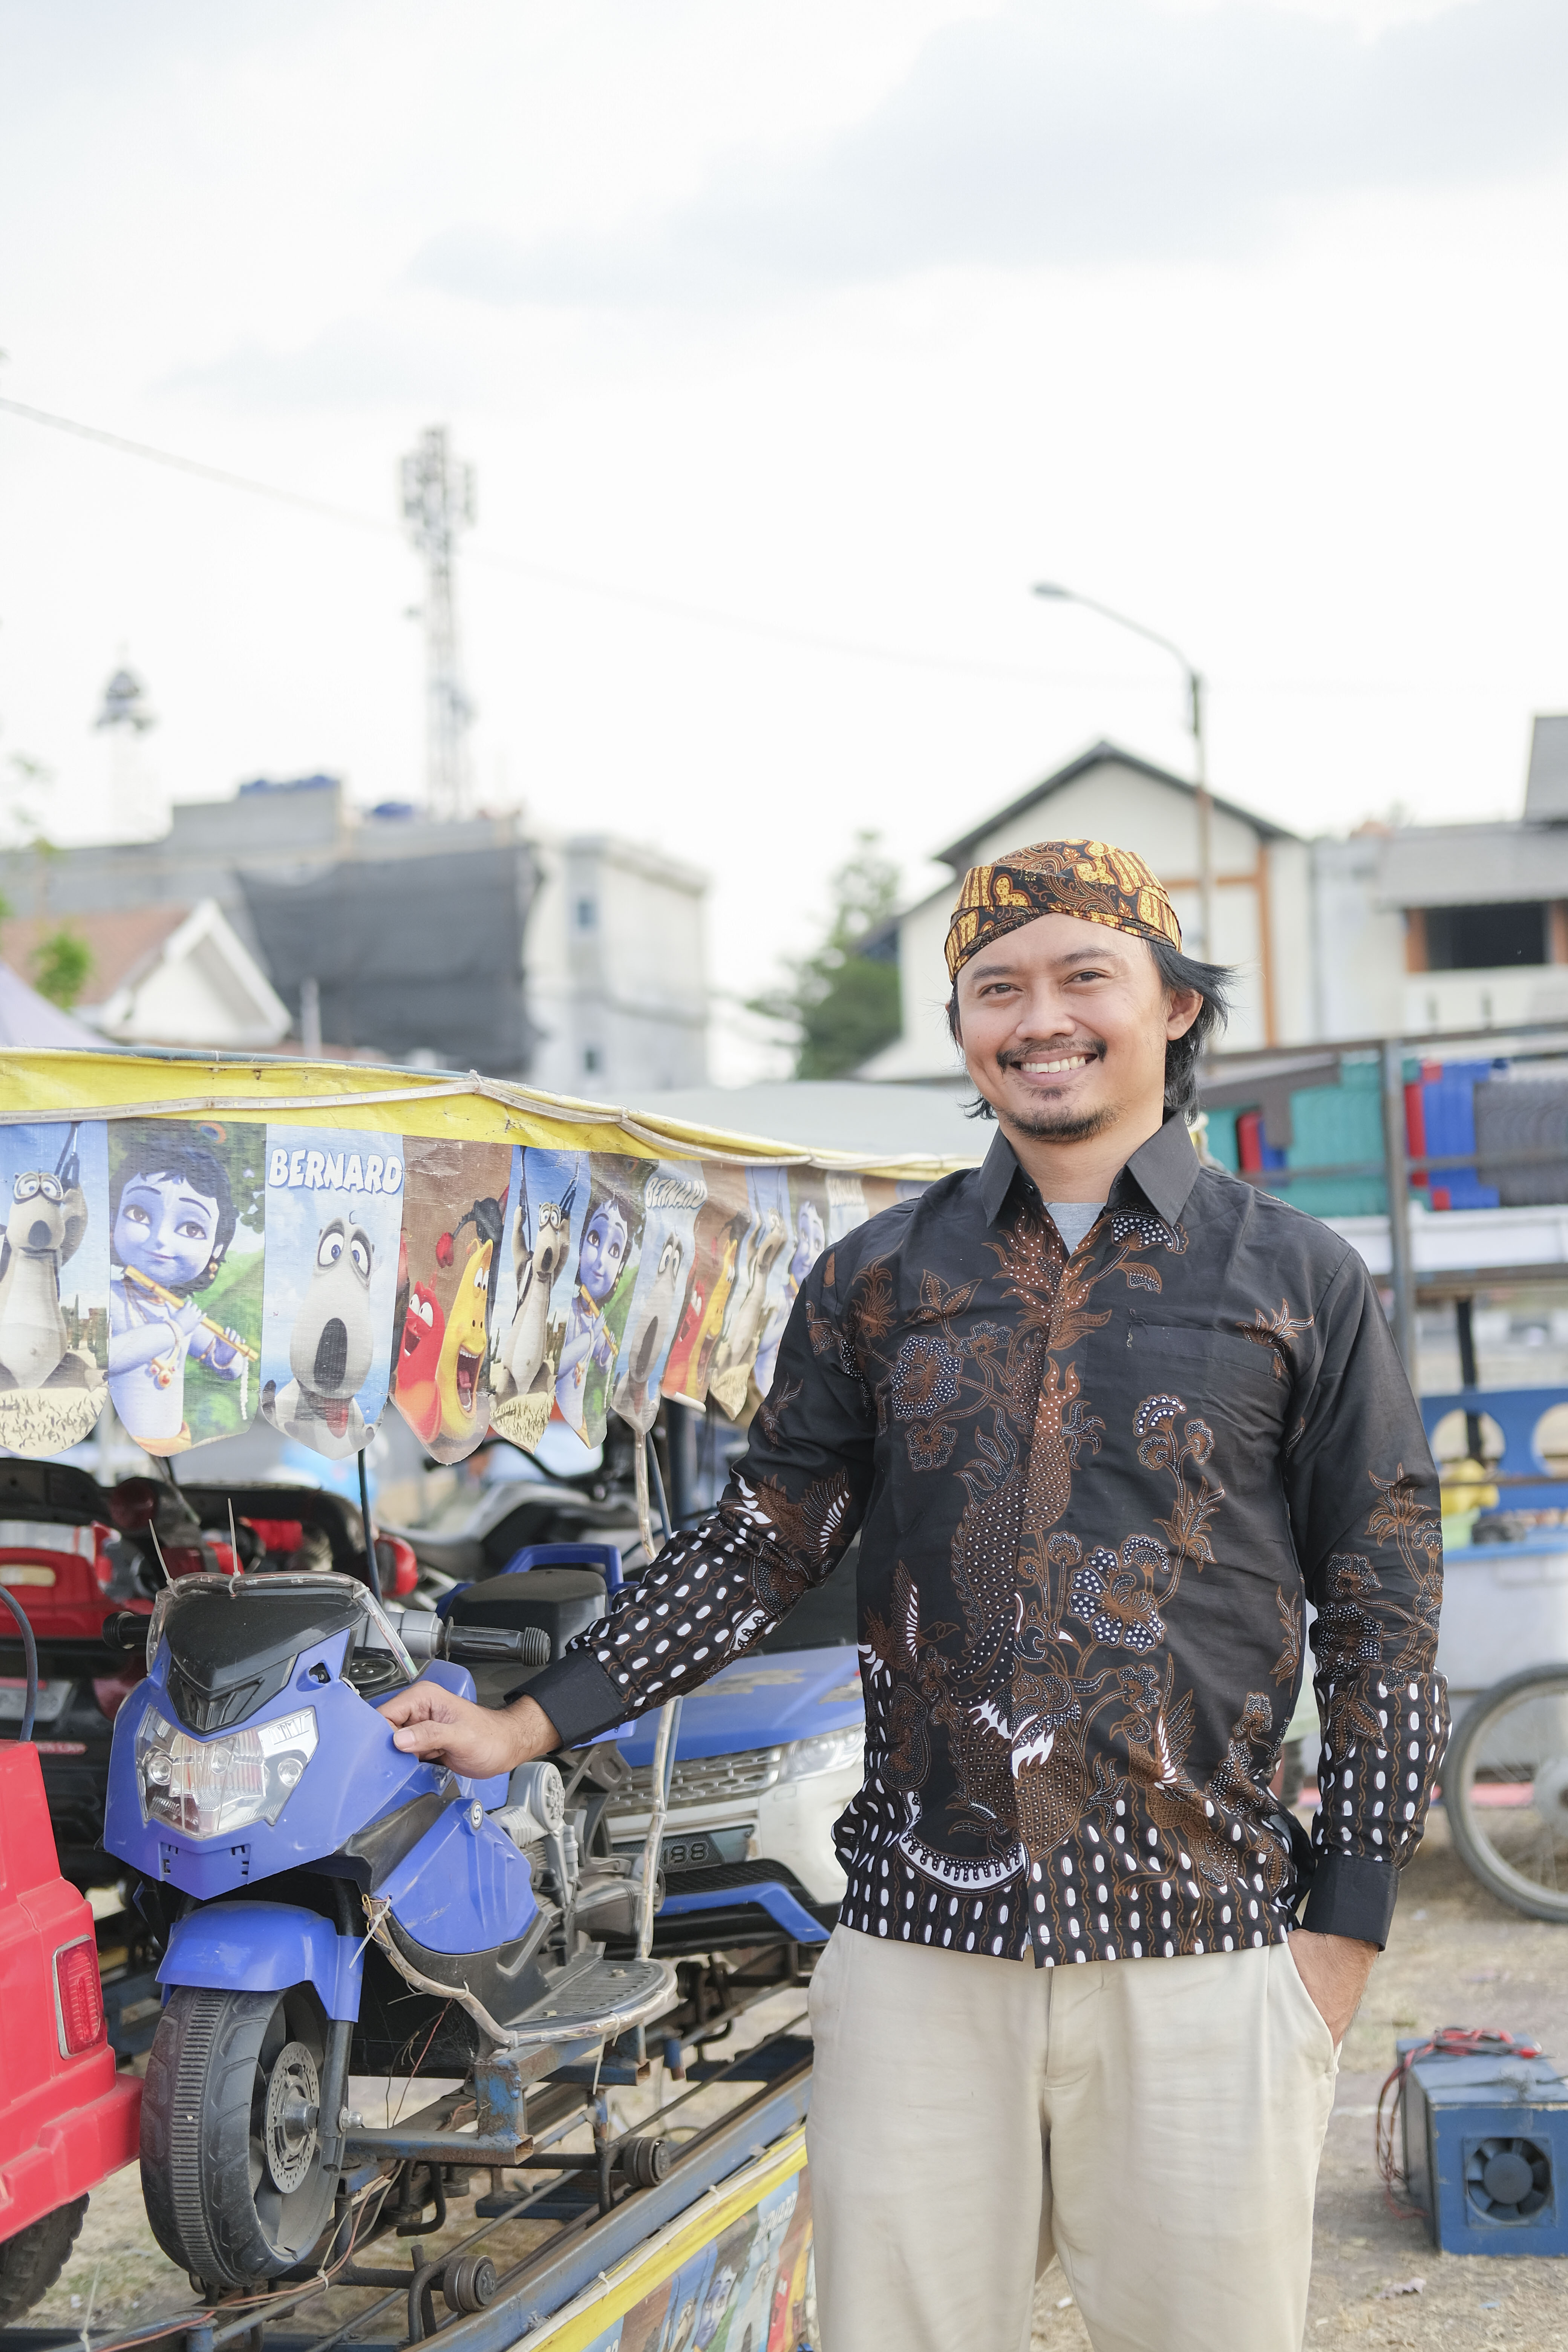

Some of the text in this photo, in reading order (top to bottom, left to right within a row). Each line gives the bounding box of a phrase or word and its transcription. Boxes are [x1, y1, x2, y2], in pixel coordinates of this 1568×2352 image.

[268, 1148, 404, 1194] BERNARD
[646, 1177, 708, 1209] BERNARD
[664, 1841, 709, 1865] 188
